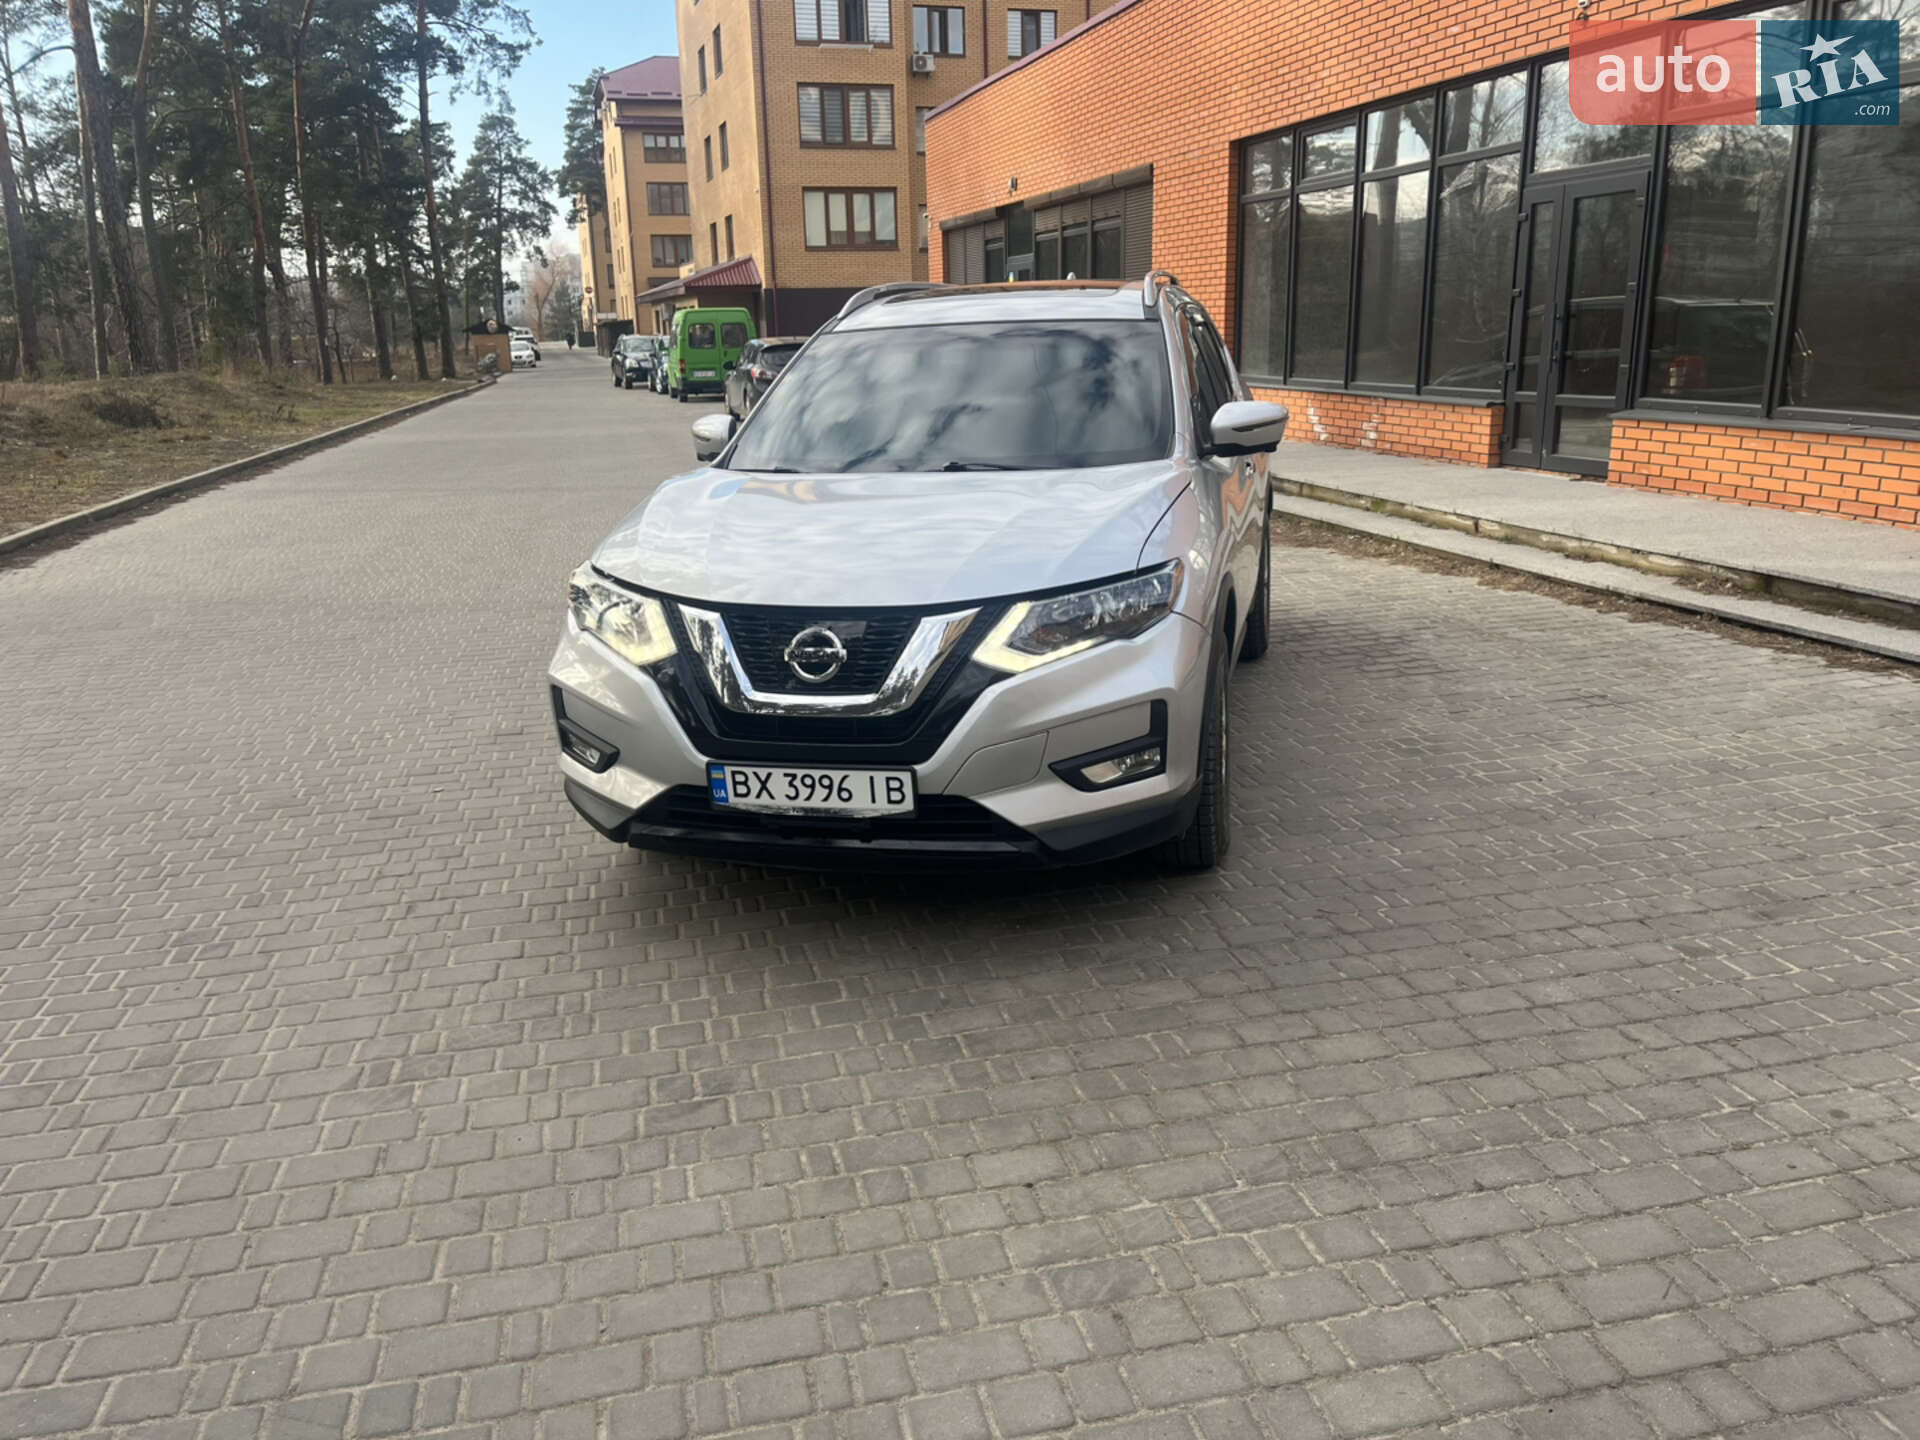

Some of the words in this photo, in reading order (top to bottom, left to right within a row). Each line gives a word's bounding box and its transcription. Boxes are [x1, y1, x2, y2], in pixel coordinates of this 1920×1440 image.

[713, 788, 727, 798] UA
[730, 770, 776, 800] BX
[783, 772, 853, 803] 3996
